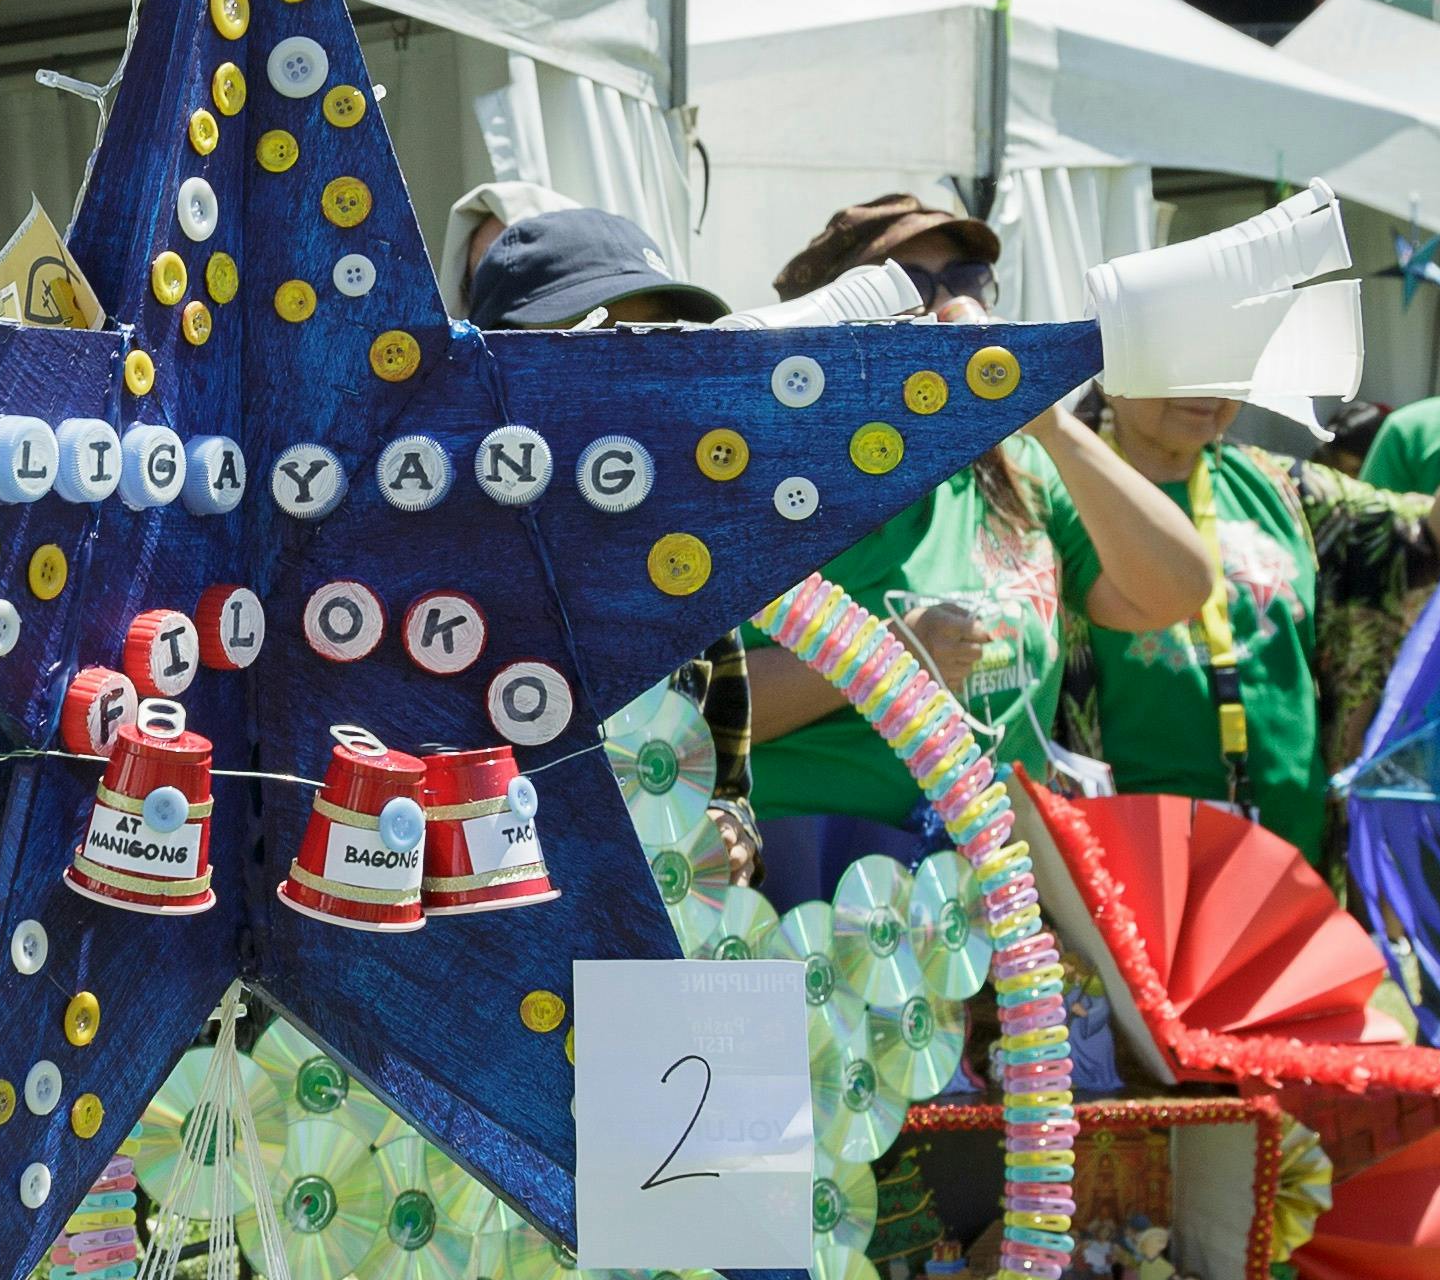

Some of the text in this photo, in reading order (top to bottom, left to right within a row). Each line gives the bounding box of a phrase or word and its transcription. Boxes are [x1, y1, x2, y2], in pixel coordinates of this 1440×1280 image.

[116, 816, 142, 835] AT
[89, 832, 188, 865] MANIGONG
[344, 845, 419, 868] BAGONG
[641, 1055, 719, 1190] 2
